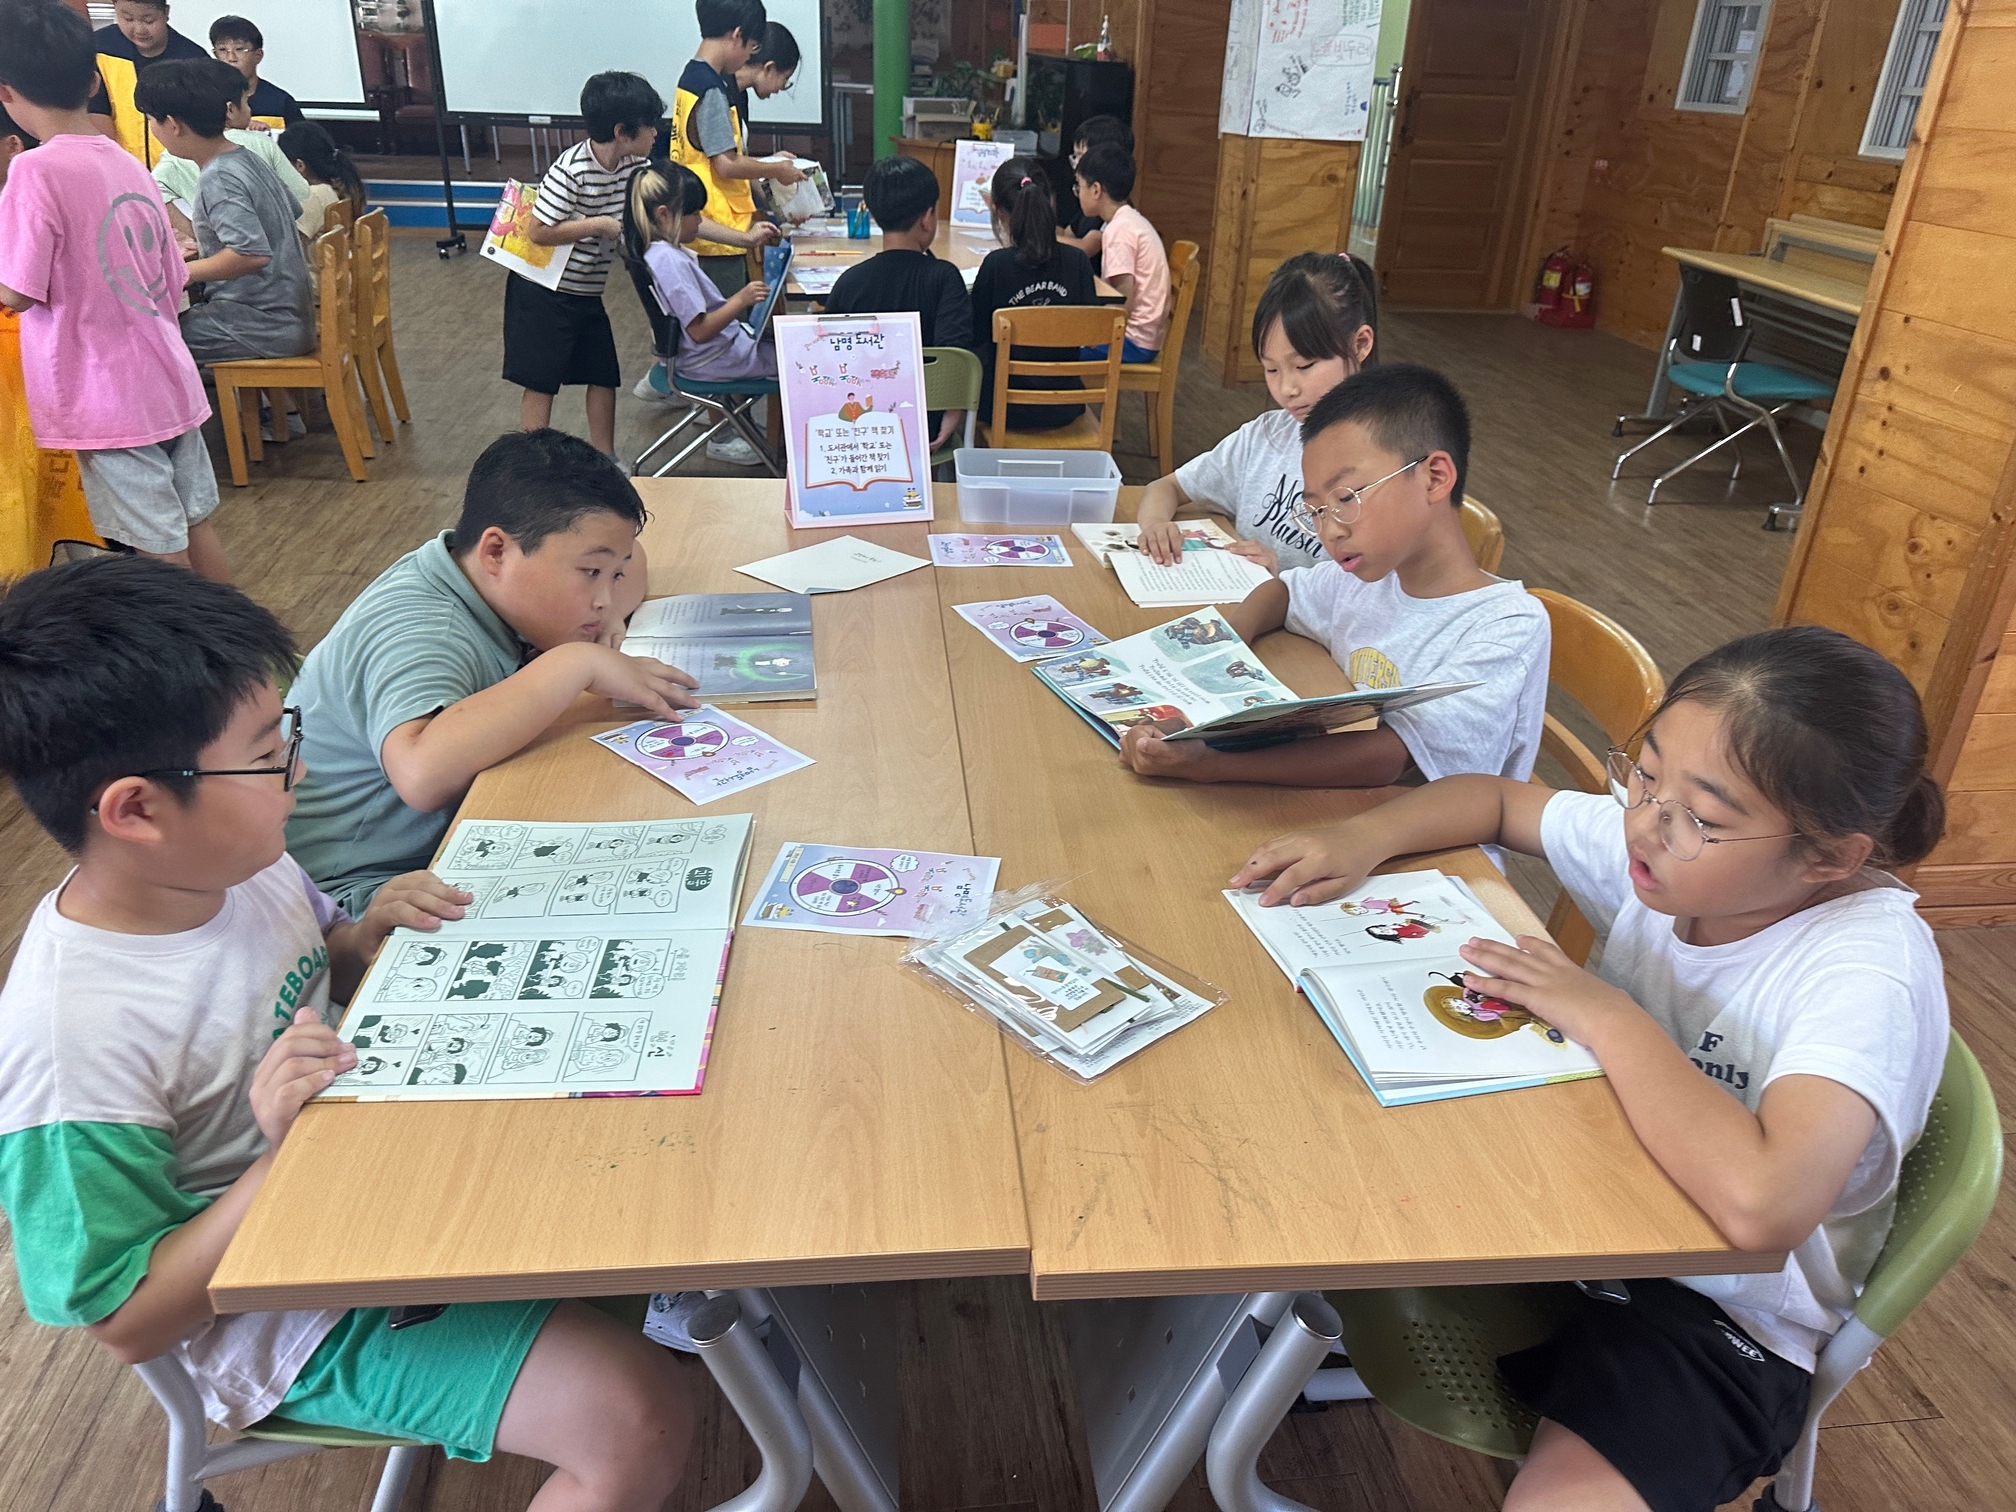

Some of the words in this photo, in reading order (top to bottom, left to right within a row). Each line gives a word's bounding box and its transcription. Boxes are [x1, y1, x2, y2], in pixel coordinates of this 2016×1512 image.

[1008, 289, 1026, 306] THE
[1025, 281, 1047, 296] BEAR
[1047, 281, 1068, 297] BAND
[830, 337, 853, 351] 남명
[855, 333, 886, 350] 도서관
[1689, 1056, 1750, 1090] nly
